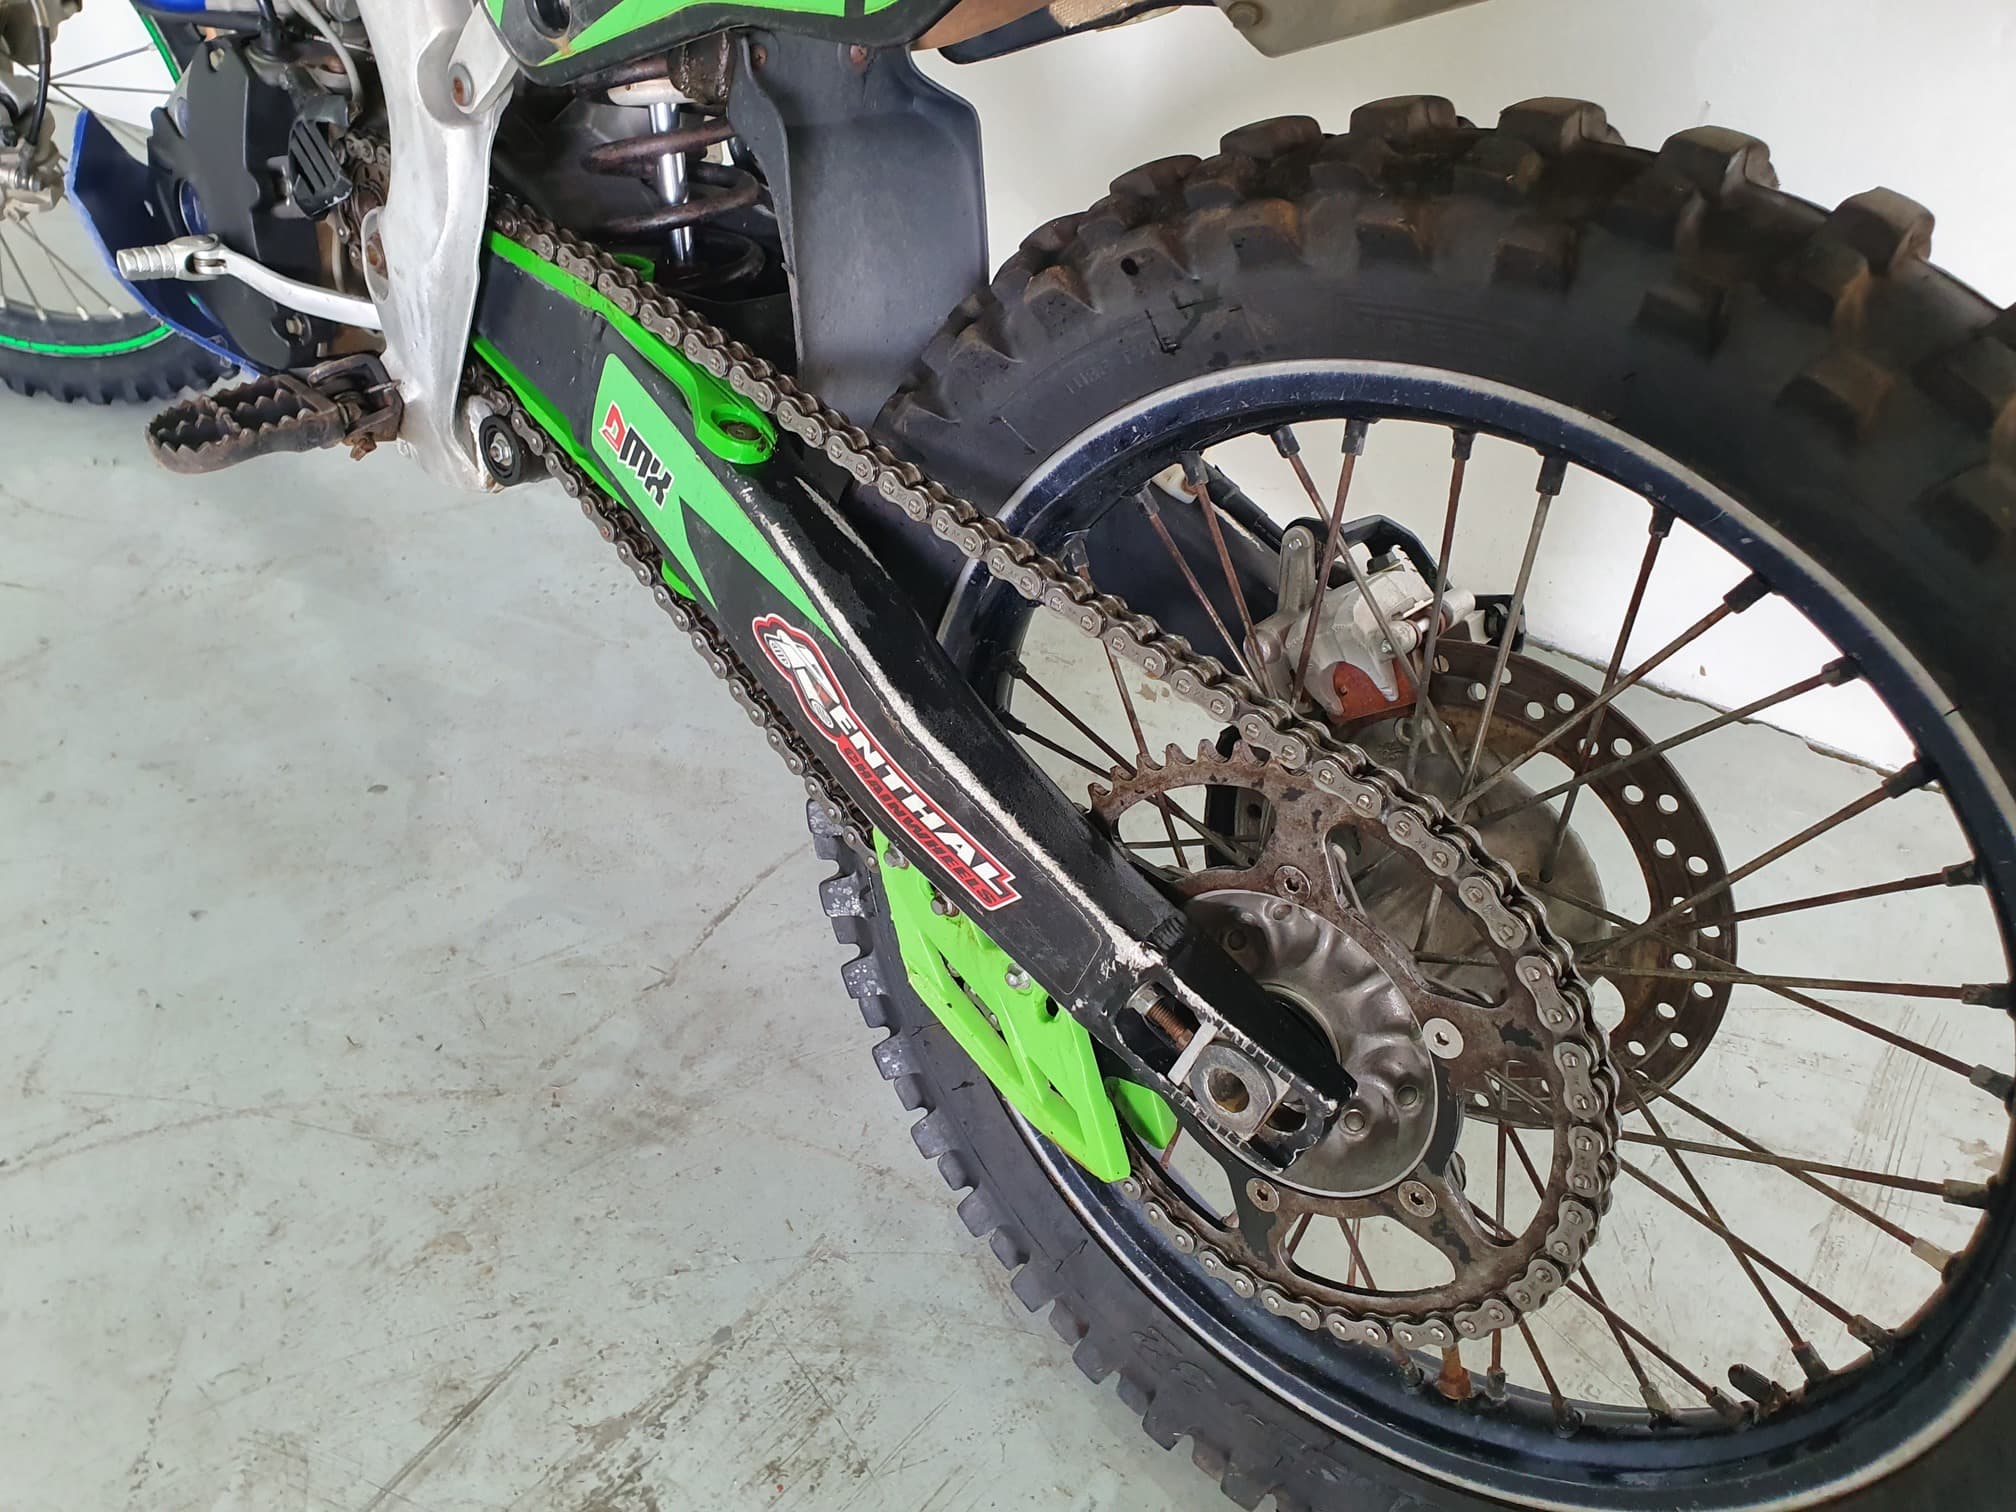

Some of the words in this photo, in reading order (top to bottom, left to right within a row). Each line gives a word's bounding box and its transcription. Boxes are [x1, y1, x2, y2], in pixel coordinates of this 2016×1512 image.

[601, 402, 674, 507] DMX
[765, 629, 1010, 898] RENTHAL
[845, 746, 999, 905] CHAINWHEELS
